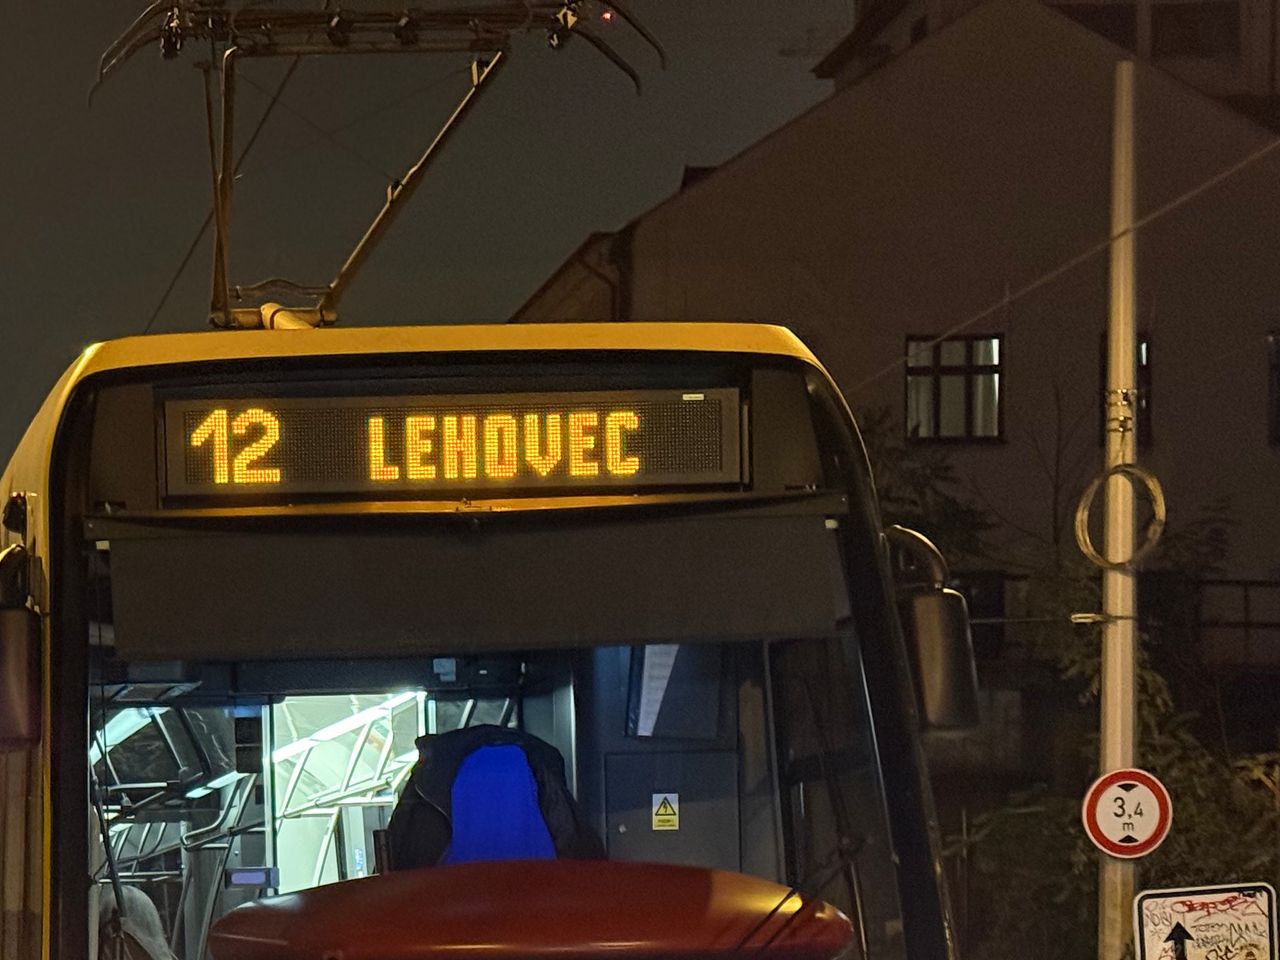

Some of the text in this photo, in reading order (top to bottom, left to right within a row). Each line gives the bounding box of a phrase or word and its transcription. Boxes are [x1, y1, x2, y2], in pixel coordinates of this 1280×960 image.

[190, 407, 641, 485] 12 LEHOVEC
[1113, 796, 1144, 820] 3,4
[1122, 821, 1135, 832] m
